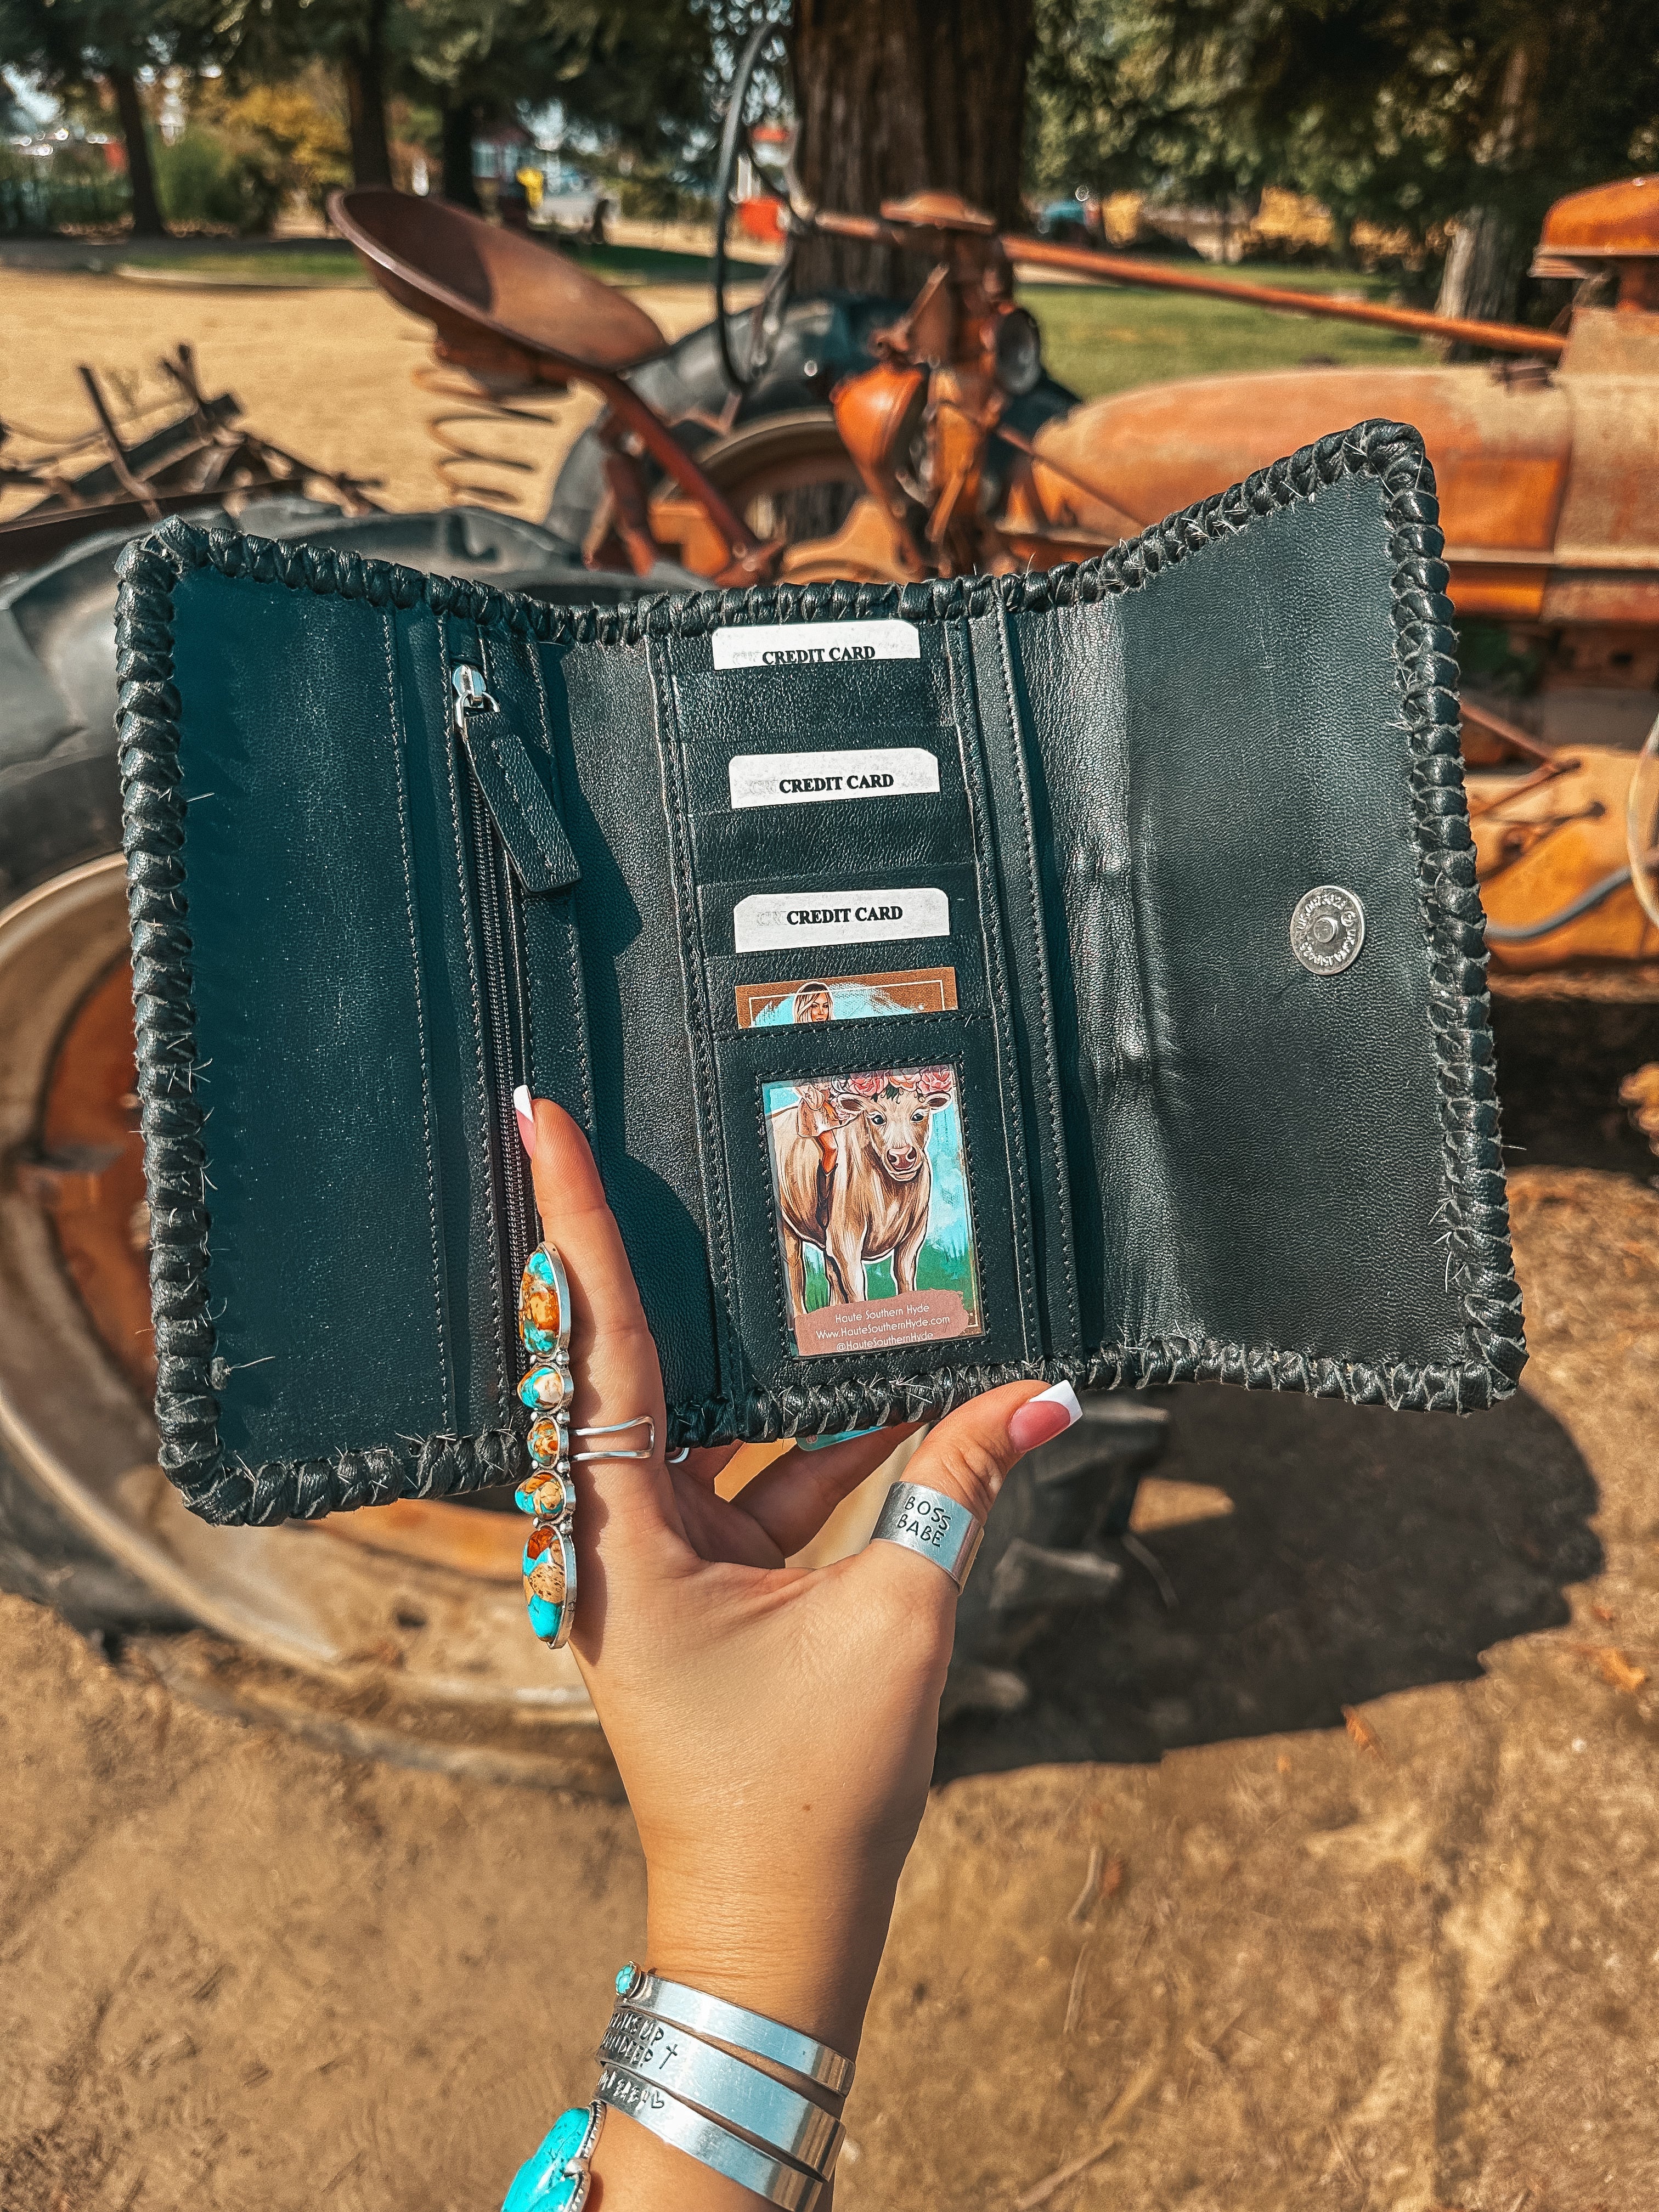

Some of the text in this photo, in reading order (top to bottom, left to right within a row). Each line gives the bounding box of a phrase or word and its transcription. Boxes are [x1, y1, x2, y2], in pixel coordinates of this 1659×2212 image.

[762, 648, 825, 665] CREDIT
[829, 646, 876, 661] CARD
[779, 777, 843, 793] CREDIT
[847, 774, 894, 789] CARD
[786, 909, 851, 925] CREDIT
[855, 906, 903, 921] CARD
[835, 1304, 930, 1324] Haute Southern Hyde
[816, 1315, 950, 1340] Www.HauteSouthernHyde.com
[836, 1331, 934, 1352] @HauteSouthernHyde
[904, 1496, 952, 1531] BOSS
[896, 1513, 946, 1548] BABE
[639, 2019, 664, 2046] UP
